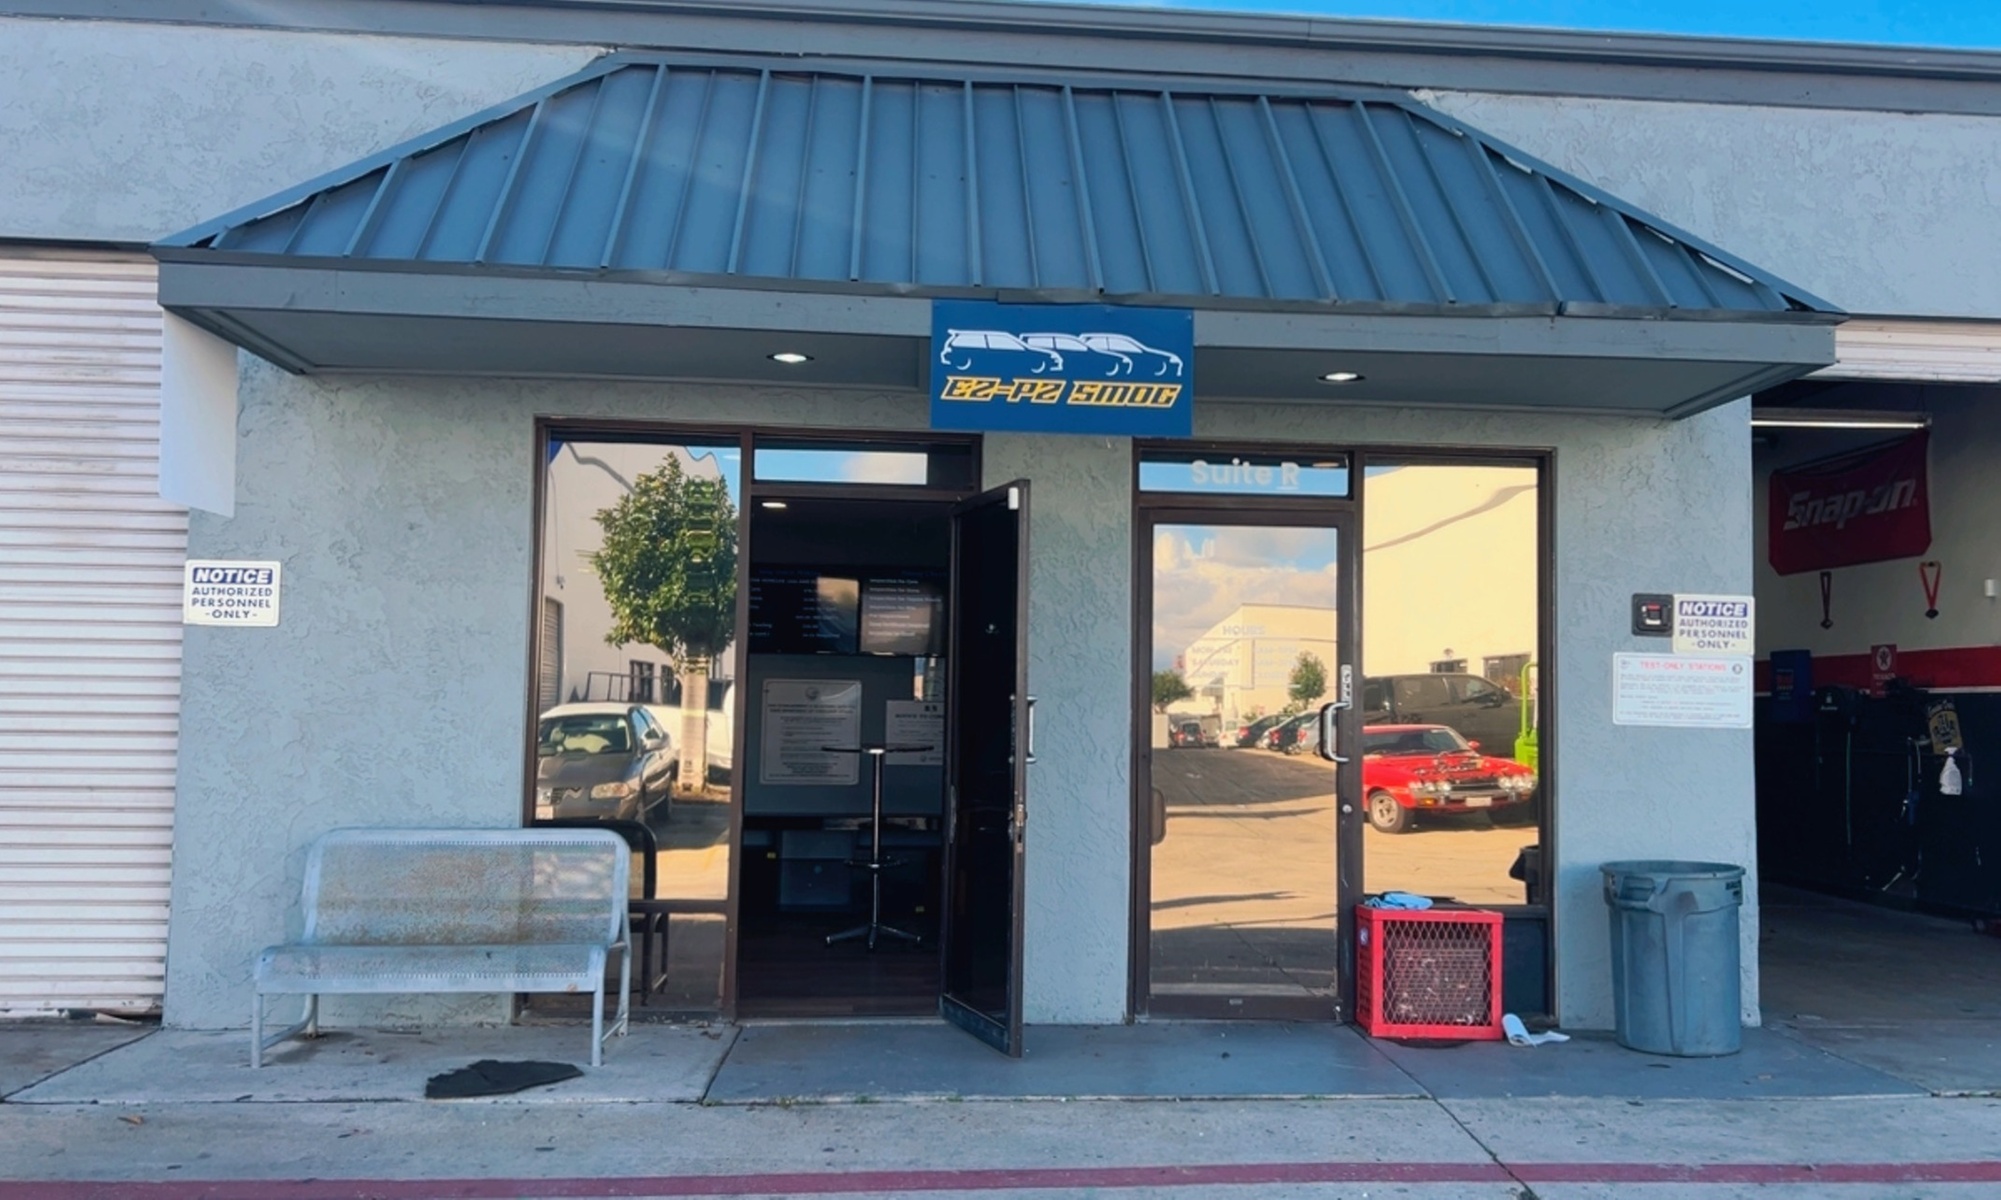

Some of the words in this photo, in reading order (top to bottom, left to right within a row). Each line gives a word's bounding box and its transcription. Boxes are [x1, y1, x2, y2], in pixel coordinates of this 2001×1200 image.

[940, 376, 1066, 403] EZ-PZ
[1067, 381, 1182, 408] SMOG
[1191, 457, 1272, 485] Suite
[1281, 462, 1300, 486] R
[1783, 479, 1916, 530] Snap-on
[194, 568, 271, 584] NOTICE
[192, 587, 272, 597] AUTHORIZED
[191, 598, 271, 608] PERSONNEL
[1681, 602, 1746, 617] NOTICE
[1679, 619, 1748, 629] AUTHORIZED
[1679, 630, 1748, 640] PERSONNEL
